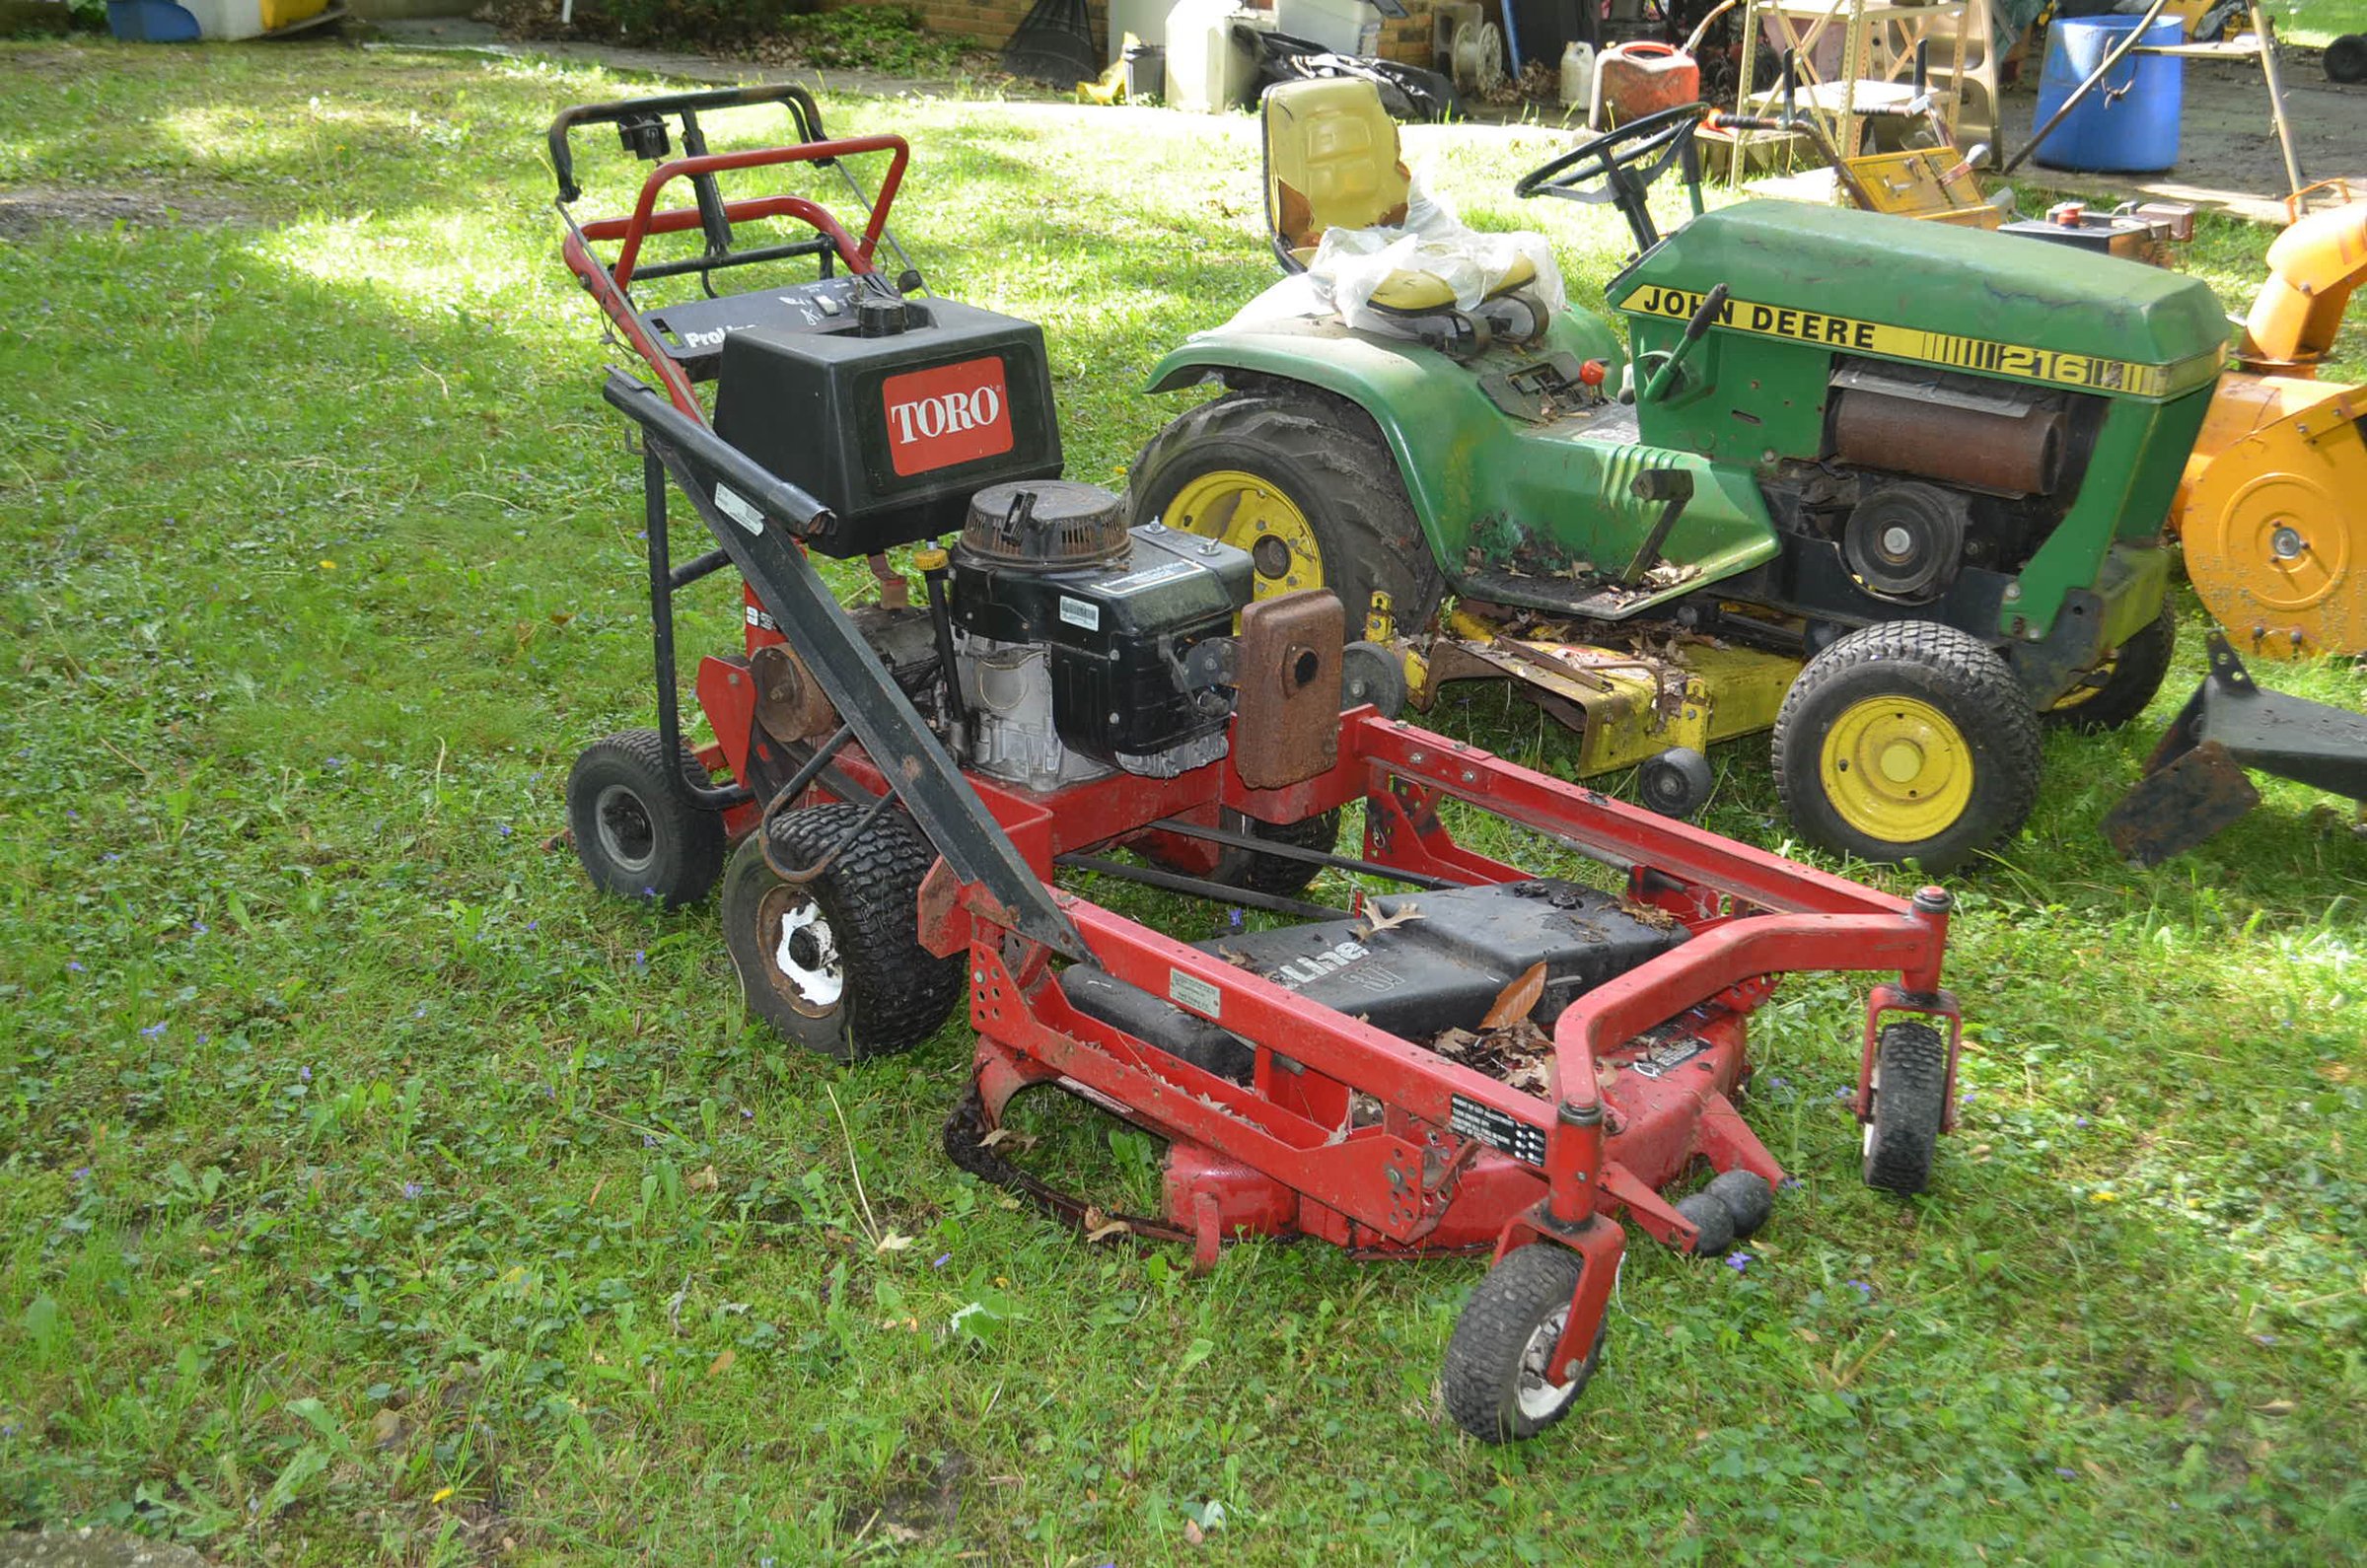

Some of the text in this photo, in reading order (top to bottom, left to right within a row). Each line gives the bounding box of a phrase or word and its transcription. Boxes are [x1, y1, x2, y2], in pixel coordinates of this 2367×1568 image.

[1752, 306, 1876, 348] DEERE
[2000, 345, 2088, 385] 216
[891, 386, 999, 444] TORO
